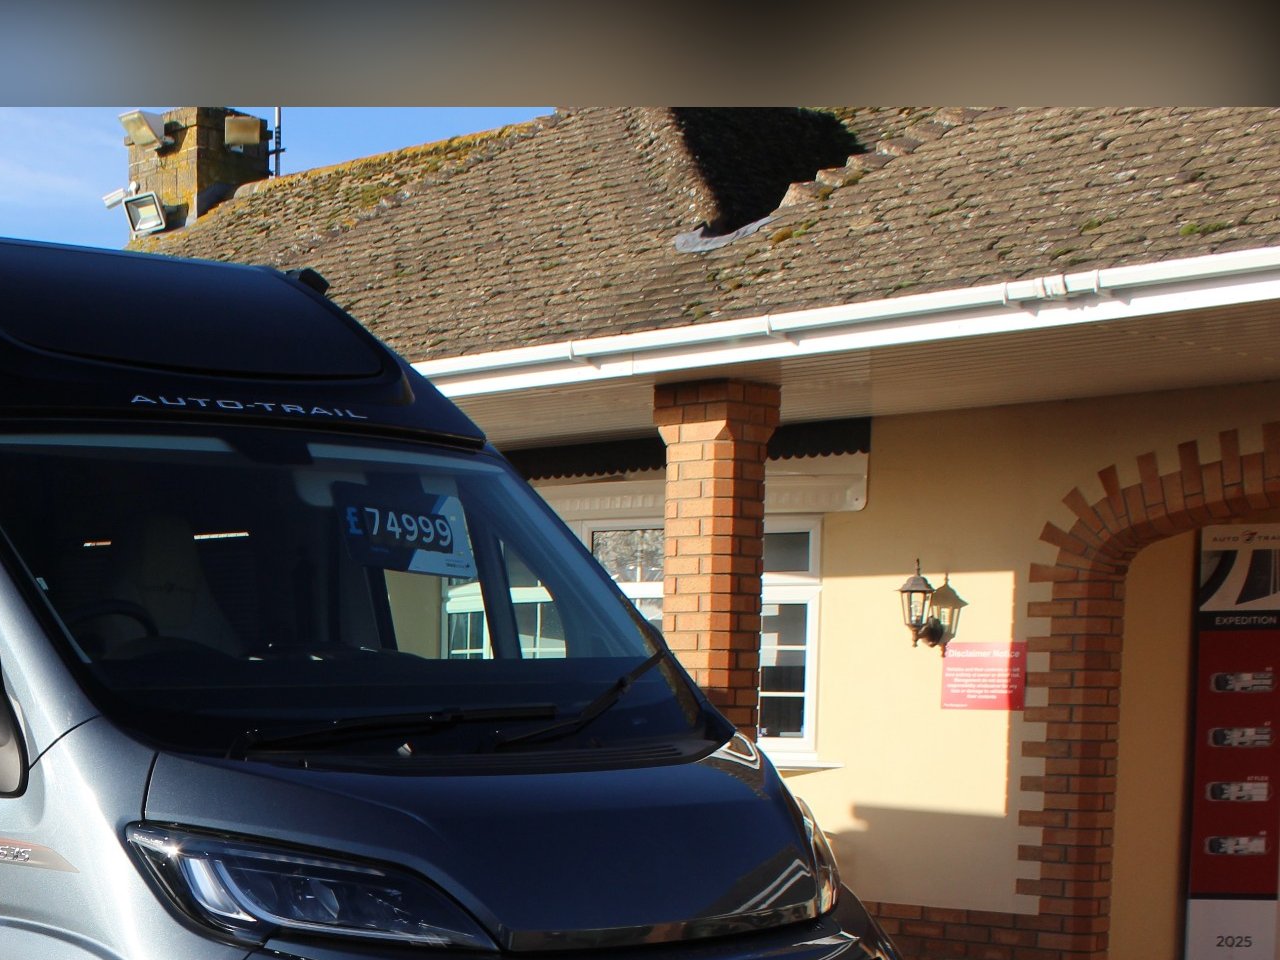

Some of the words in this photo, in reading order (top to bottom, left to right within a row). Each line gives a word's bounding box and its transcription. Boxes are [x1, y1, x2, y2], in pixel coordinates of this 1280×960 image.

[131, 395, 368, 419] AUTO-TRAIL
[1215, 616, 1277, 625] EXPEDITION
[948, 649, 991, 657] Disclaimer
[992, 649, 1020, 658] Notice
[1216, 935, 1252, 948] 2025
